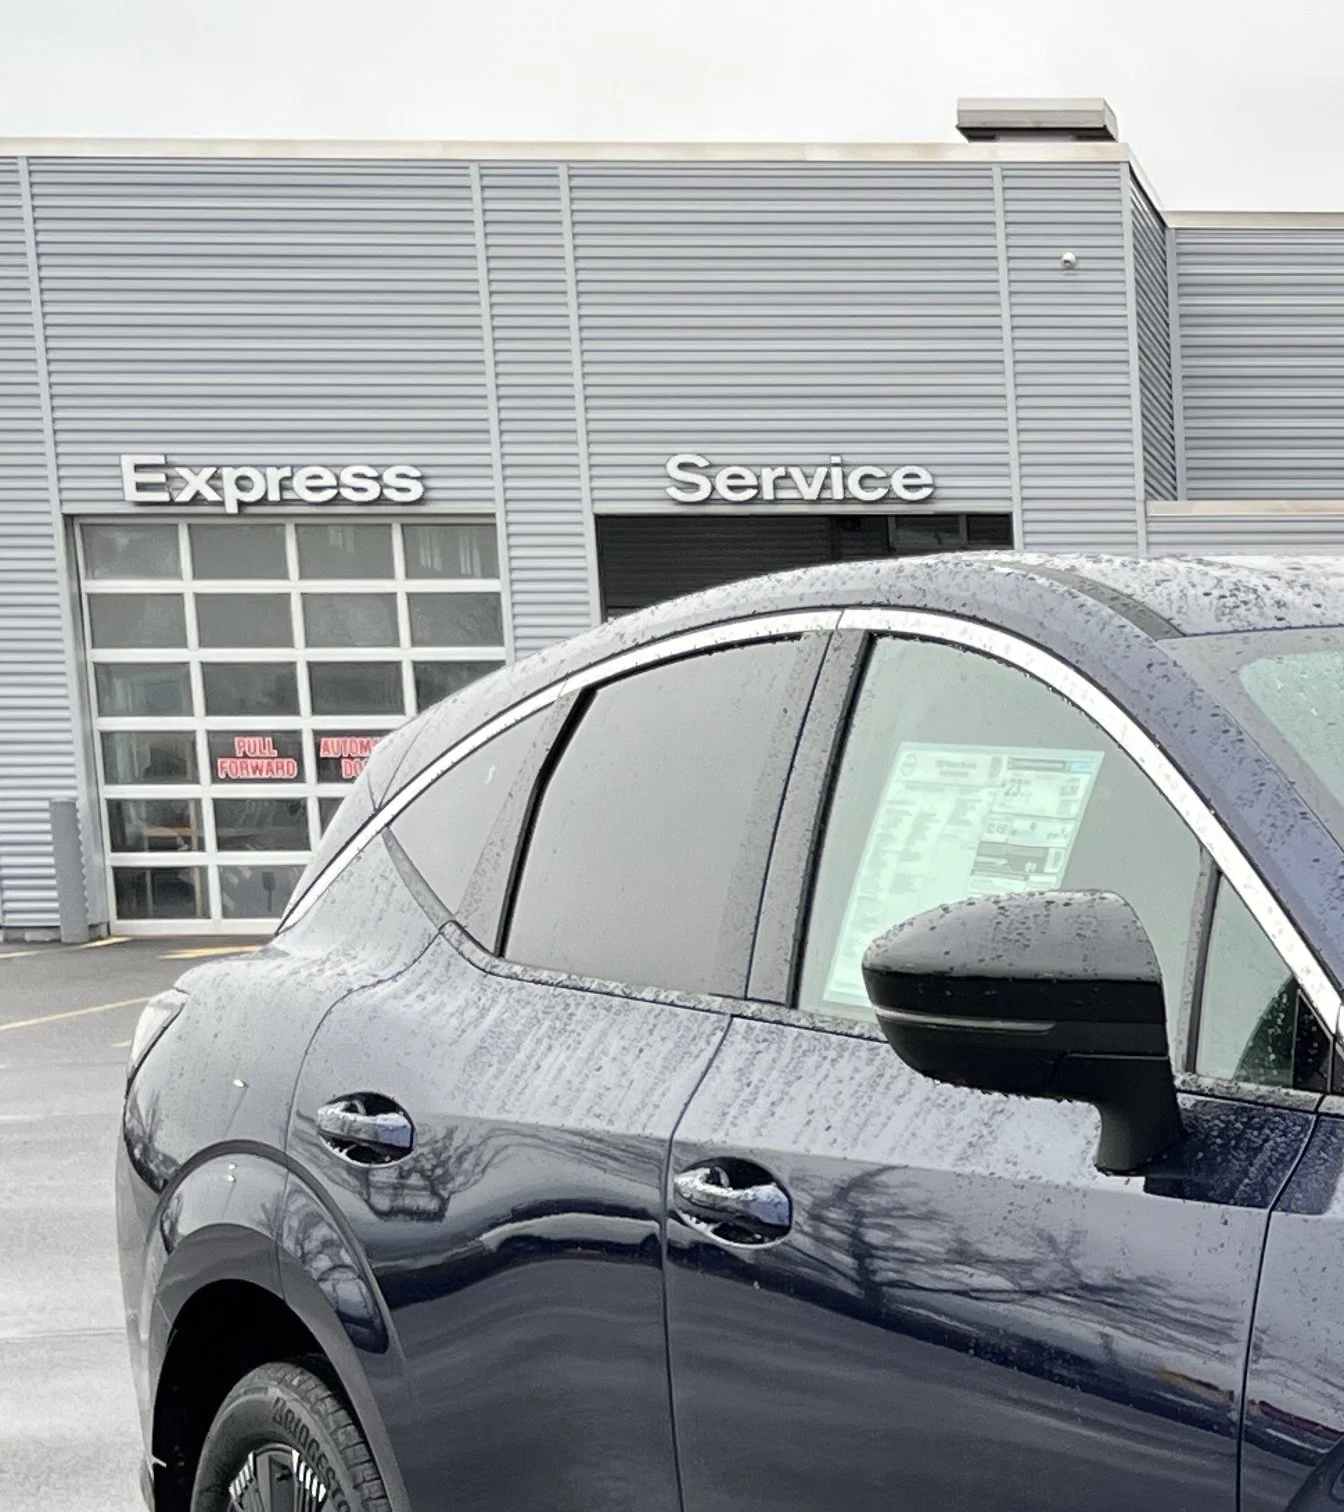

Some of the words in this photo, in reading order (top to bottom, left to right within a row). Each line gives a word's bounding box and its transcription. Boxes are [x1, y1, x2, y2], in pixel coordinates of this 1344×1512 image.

[119, 454, 425, 514] Express
[665, 453, 935, 504] Service
[234, 736, 278, 757] PULL
[320, 737, 380, 757] AUTOM
[217, 758, 298, 779] FORWARD
